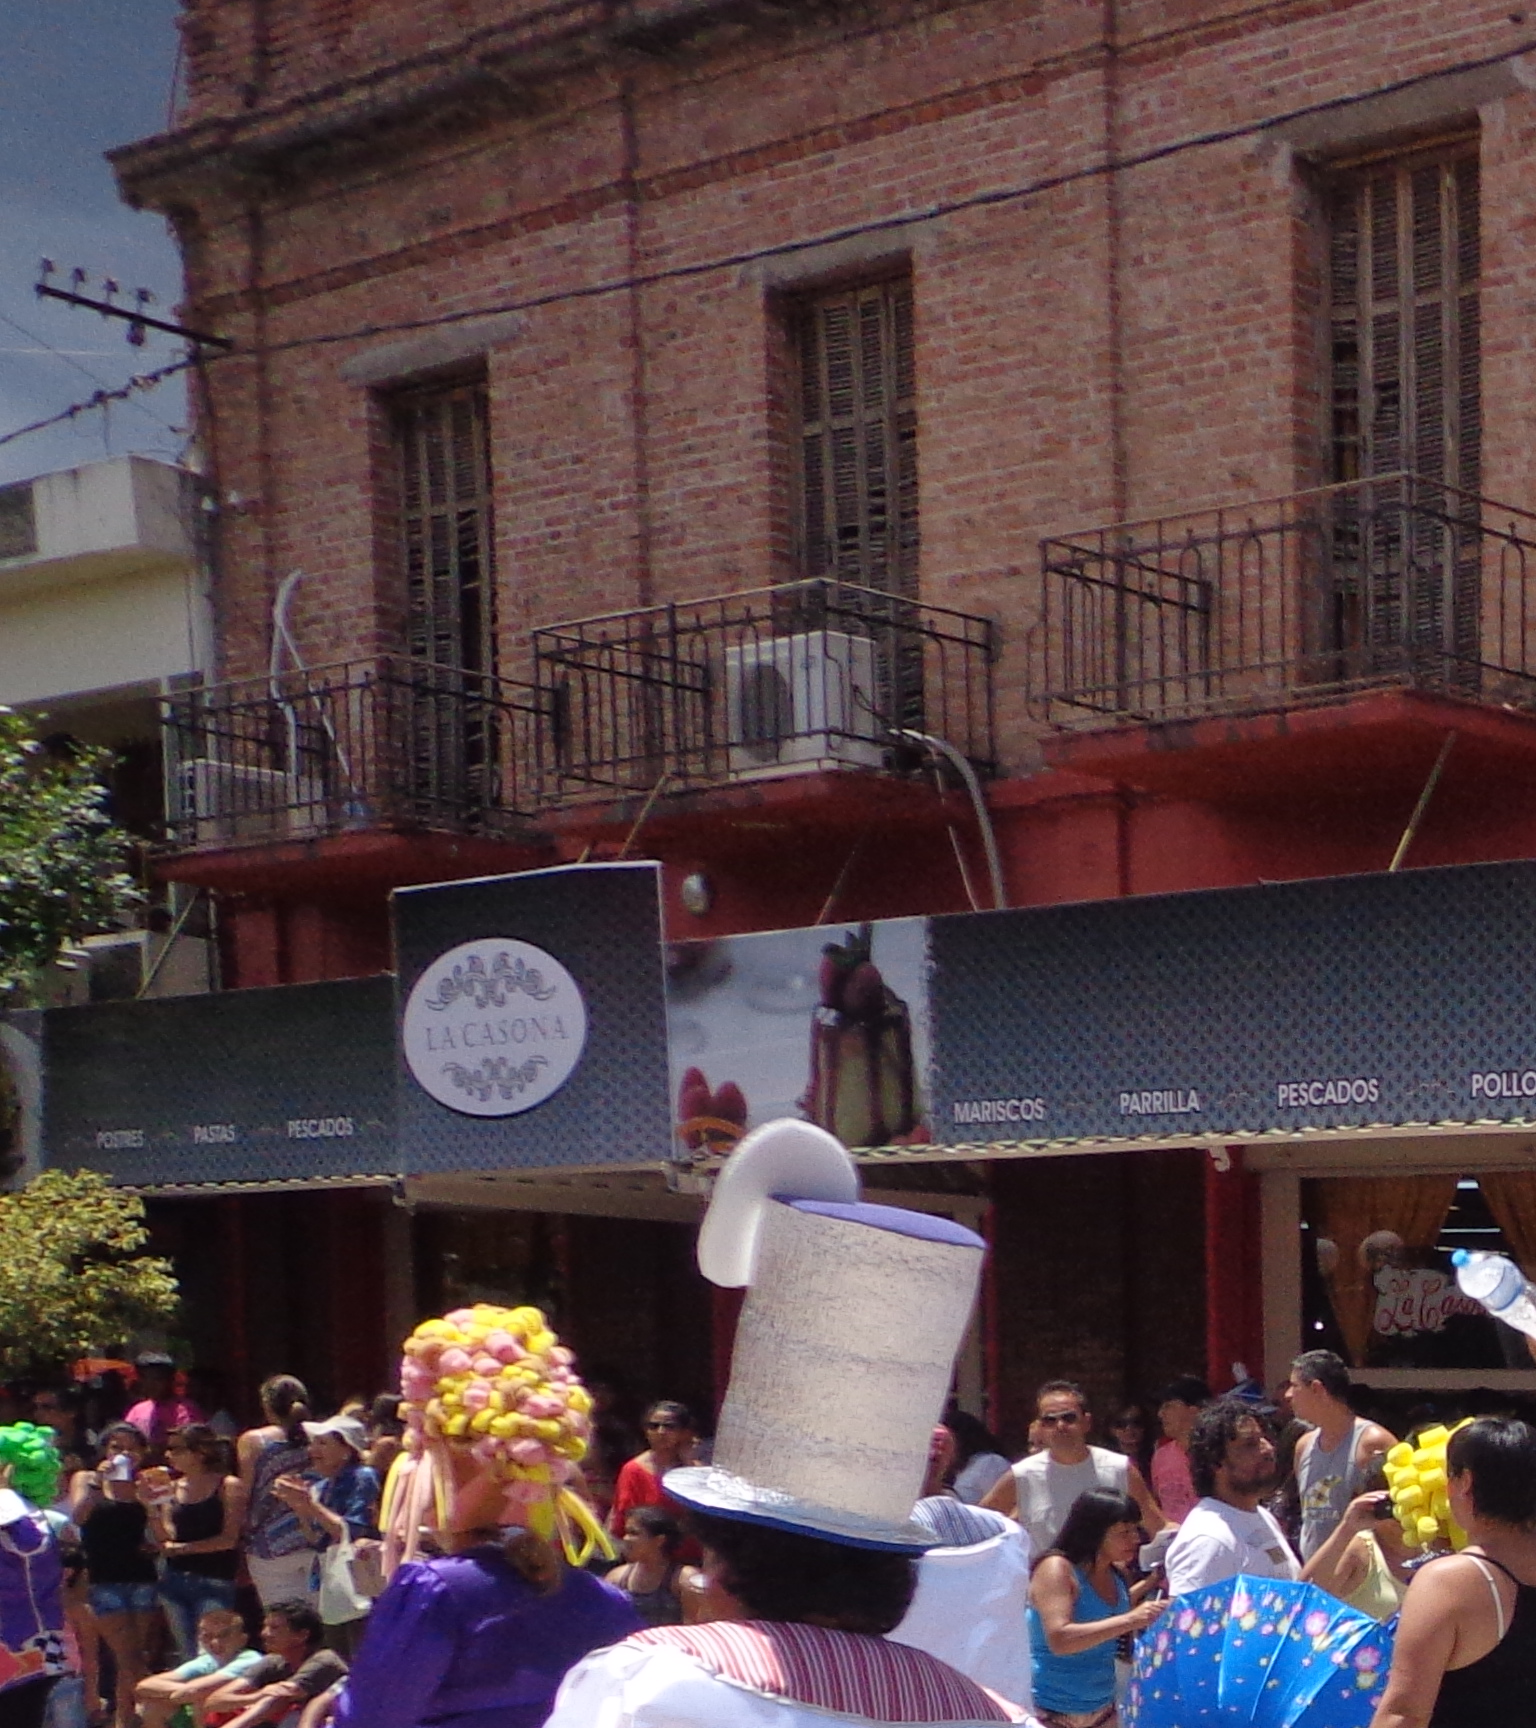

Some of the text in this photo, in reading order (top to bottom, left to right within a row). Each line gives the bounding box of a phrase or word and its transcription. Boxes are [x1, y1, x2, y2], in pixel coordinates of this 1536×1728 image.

[425, 1015, 569, 1050] LA CASONA
[954, 1097, 1045, 1123] MARISCOS
[1120, 1089, 1200, 1114] PARRILLA
[1278, 1077, 1379, 1107] PESCADOS
[193, 1124, 236, 1144] PASTAS
[288, 1117, 354, 1139] PESCADOS
